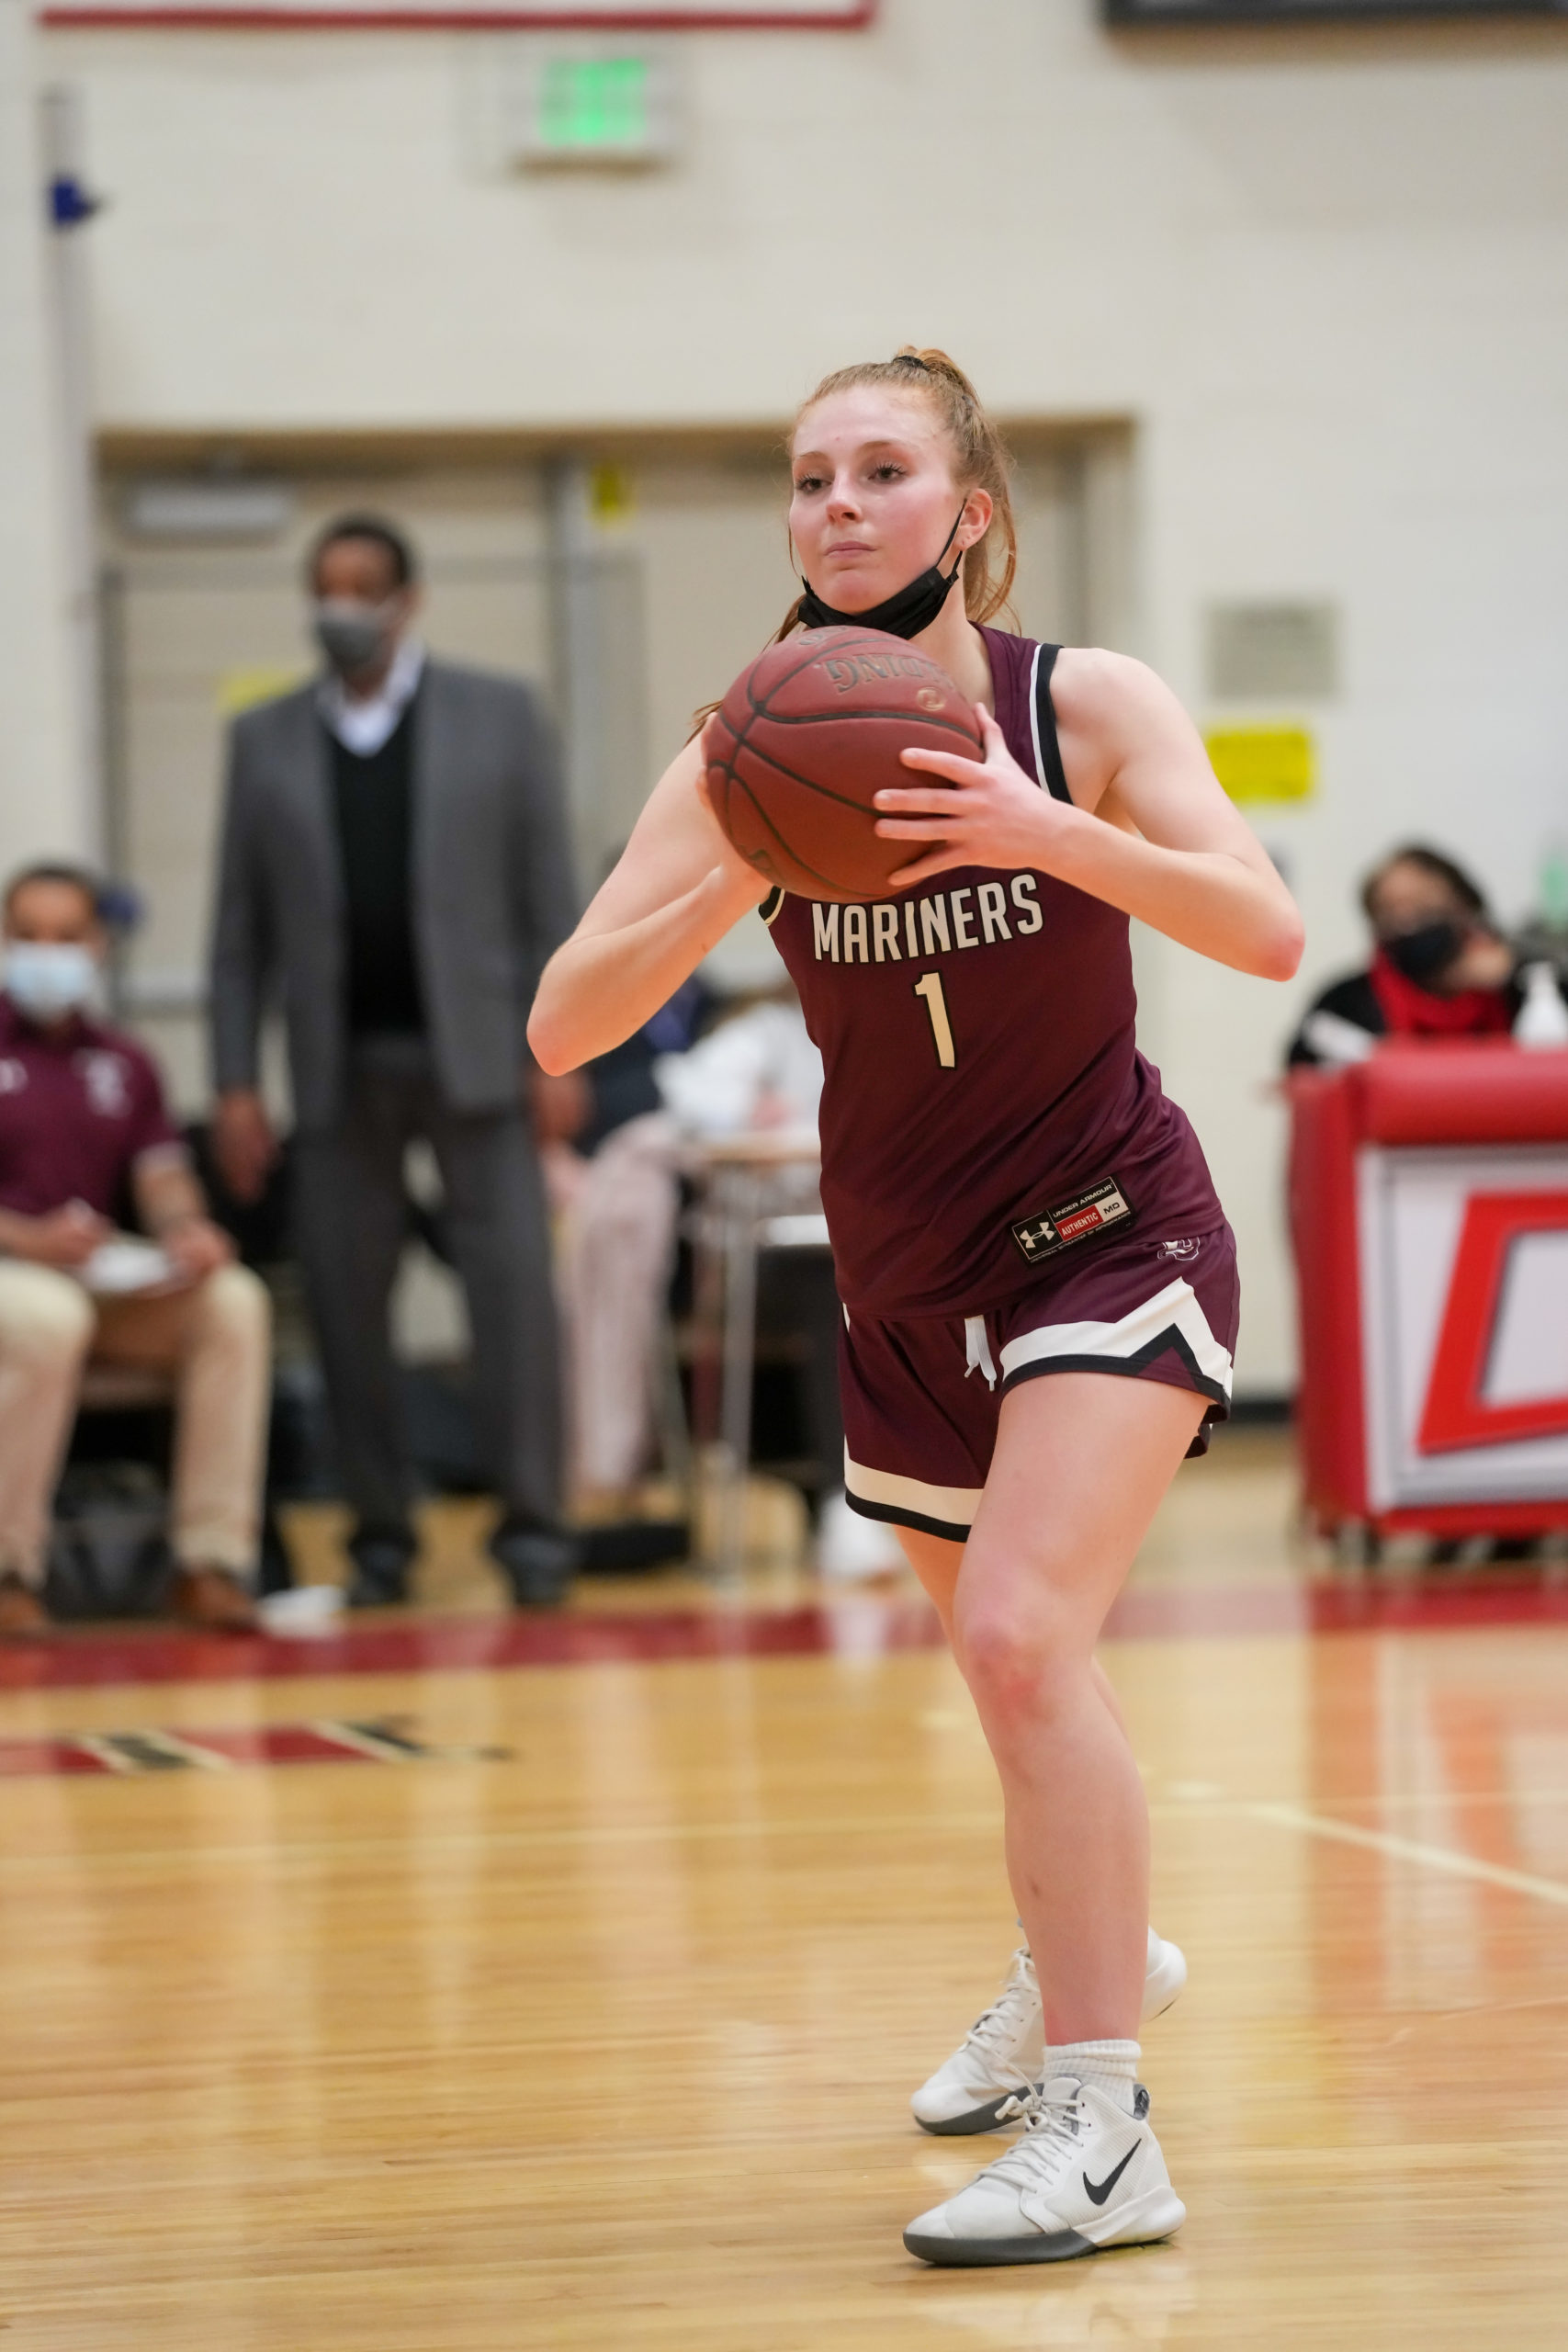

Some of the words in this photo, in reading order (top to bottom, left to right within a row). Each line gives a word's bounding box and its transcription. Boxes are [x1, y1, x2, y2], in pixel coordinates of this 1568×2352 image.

[811, 874, 1043, 964] MARINERS
[913, 971, 956, 1068] 1
[1053, 1201, 1078, 1218] UNDER
[1079, 1184, 1112, 1205] ARMOUR
[1103, 1202, 1121, 1215] MD
[1061, 1212, 1099, 1237] AUTHENTIC
